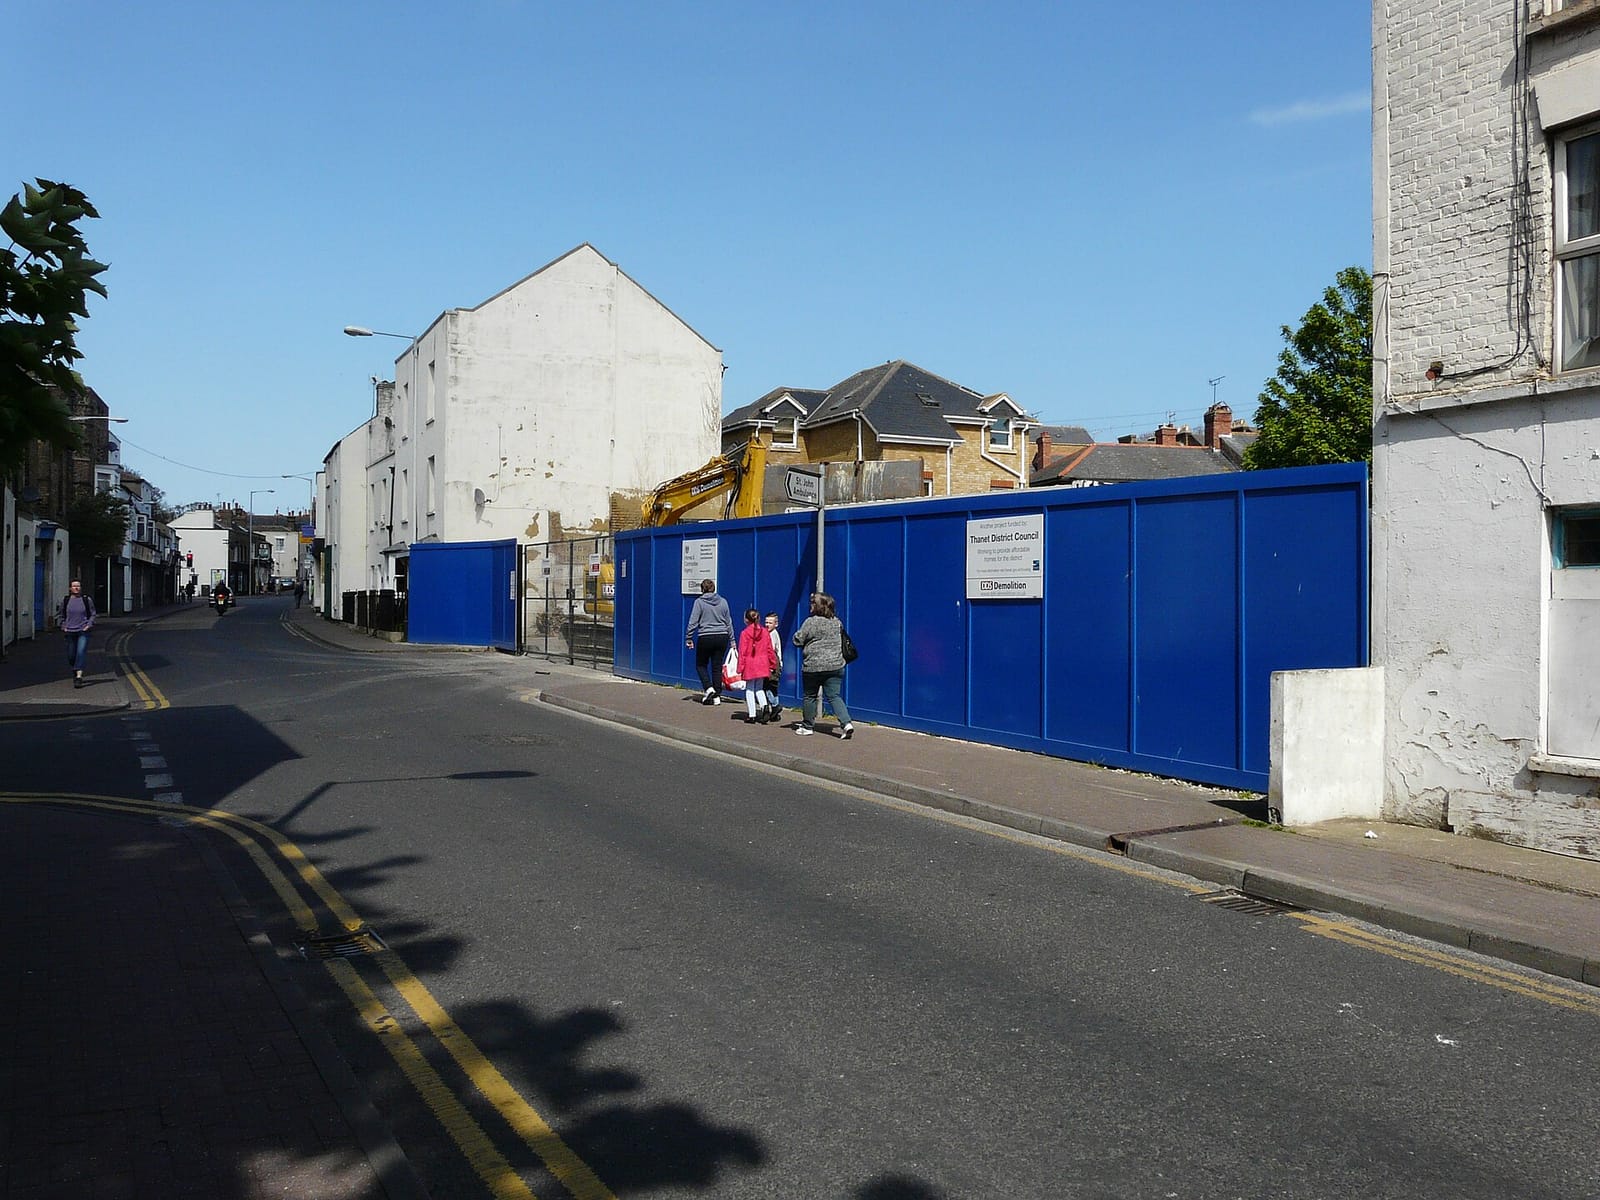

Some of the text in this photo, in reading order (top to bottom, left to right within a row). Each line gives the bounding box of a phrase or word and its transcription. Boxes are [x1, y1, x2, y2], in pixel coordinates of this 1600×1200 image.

[970, 531, 1039, 544] Thanet District Council
[994, 580, 1026, 590] Demolition
